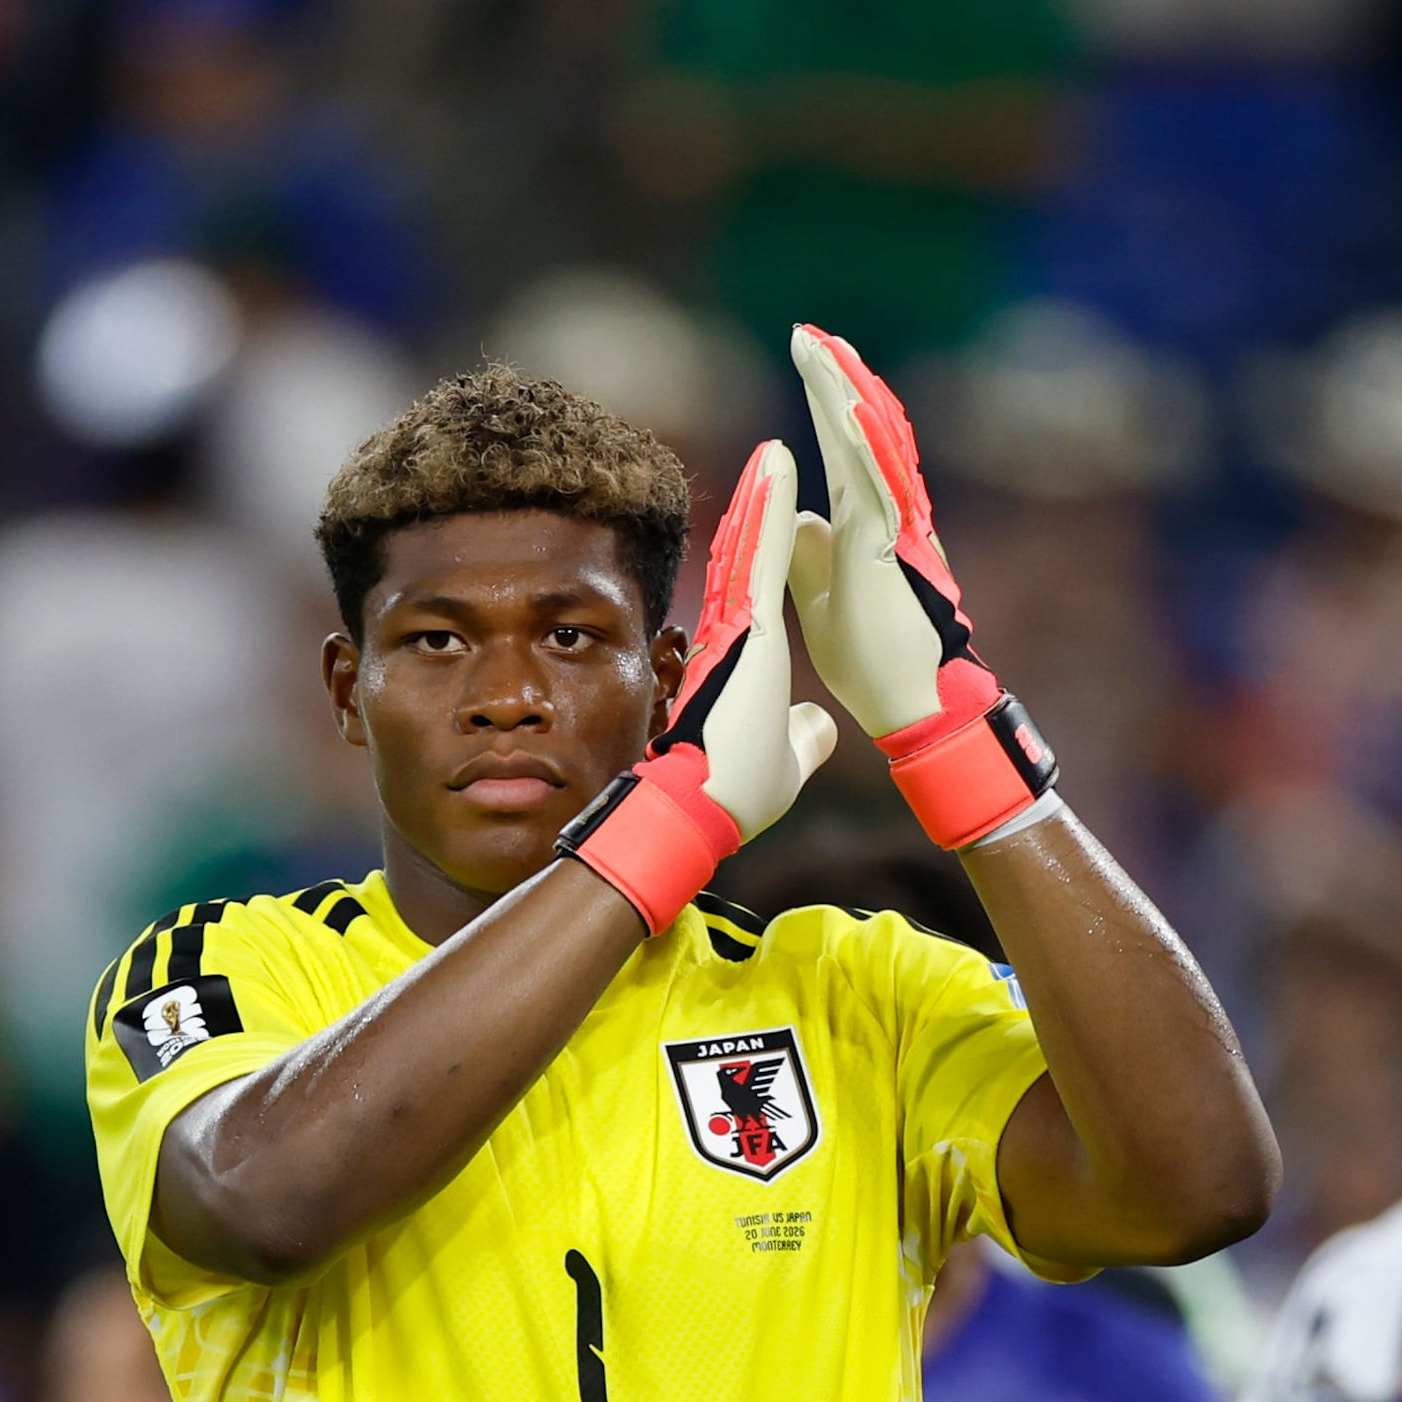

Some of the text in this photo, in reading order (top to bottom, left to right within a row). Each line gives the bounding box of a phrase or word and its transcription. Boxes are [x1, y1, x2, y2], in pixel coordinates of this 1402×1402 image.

[697, 1037, 765, 1058] JAPAN
[730, 1132, 787, 1158] JFA
[735, 1213, 770, 1228] TUNISIA
[786, 1211, 812, 1223] JAPAN
[744, 1226, 806, 1241] 20 JUNE 2026
[751, 1240, 802, 1254] MONTERREY
